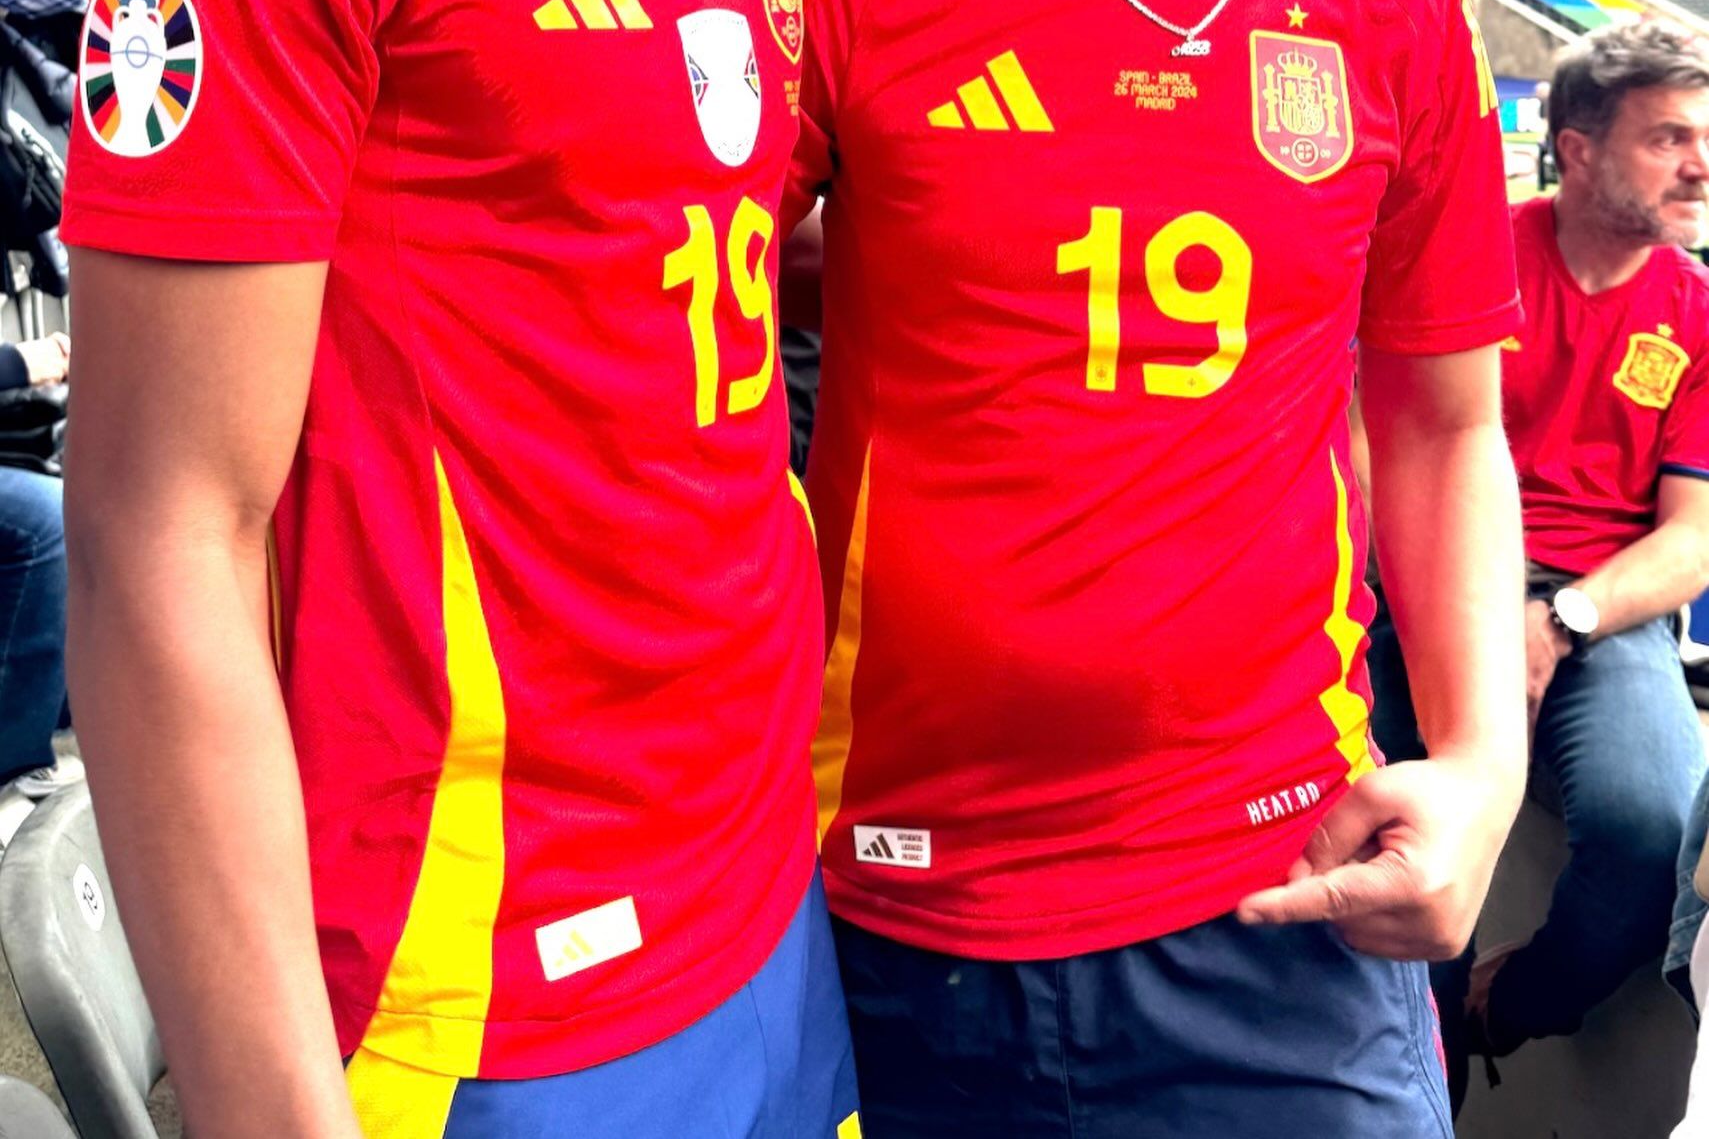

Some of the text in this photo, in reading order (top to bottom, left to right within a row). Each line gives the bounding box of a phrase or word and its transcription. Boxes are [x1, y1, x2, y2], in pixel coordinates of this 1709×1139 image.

[1120, 70, 1149, 84] SPAIN
[1159, 71, 1192, 86] BRAZIL
[1114, 82, 1198, 99] 26 MARCH 2024
[1135, 96, 1176, 110] MADRID
[1057, 206, 1252, 398] 19
[662, 195, 774, 428] 19
